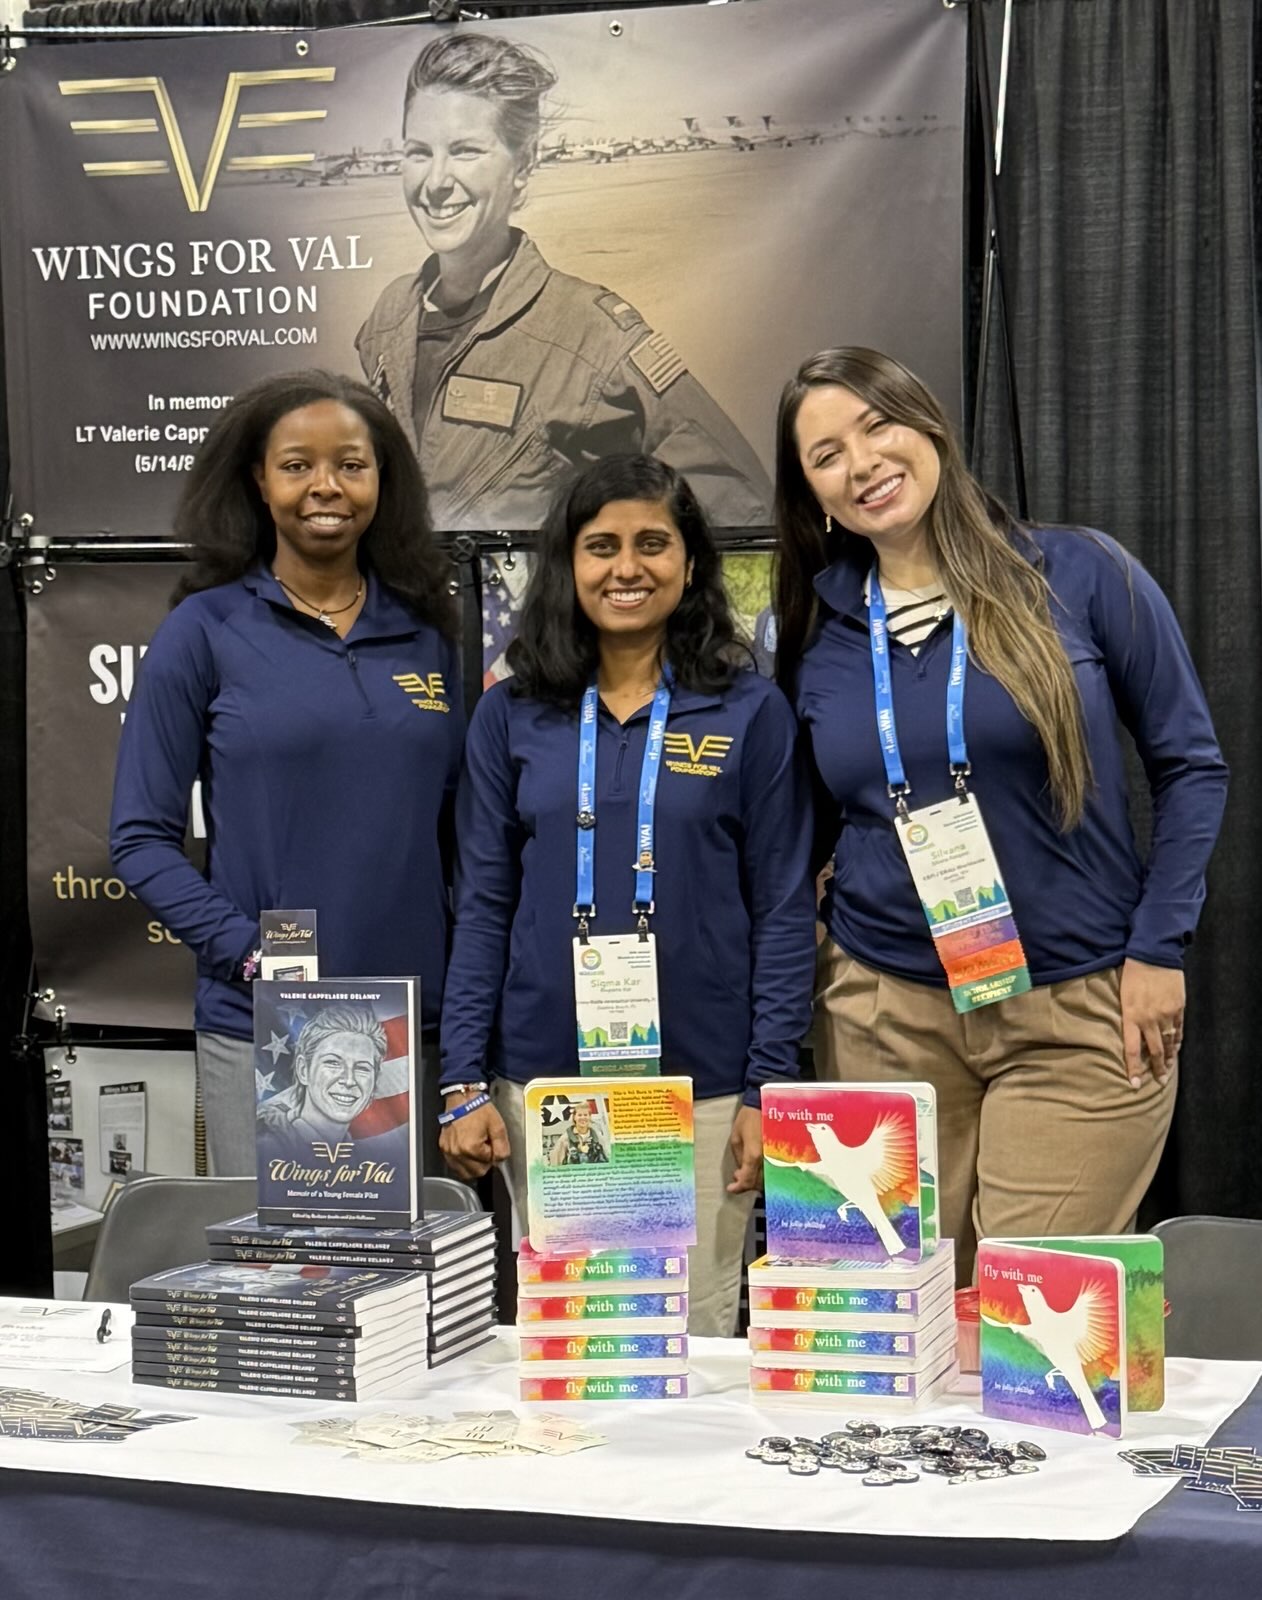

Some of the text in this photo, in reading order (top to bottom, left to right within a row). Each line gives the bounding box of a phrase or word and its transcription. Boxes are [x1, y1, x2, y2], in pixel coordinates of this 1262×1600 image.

[32, 235, 373, 281] WINGS FOR VAL
[89, 285, 318, 320] FOUNDATION
[90, 327, 318, 351] WWW.WINGSFORVAL.COM
[148, 394, 234, 411] In memor
[76, 426, 96, 443] LT
[100, 424, 160, 442] Valerie
[135, 454, 195, 473] (5/14/8
[52, 865, 137, 900] thro
[768, 1108, 834, 1122] fly with me
[268, 1159, 396, 1188] Wings for Val
[564, 1261, 637, 1277] fly with me
[984, 1264, 1043, 1284] fly with me
[795, 1291, 868, 1306] fly with me
[565, 1300, 637, 1316] fly with me
[566, 1341, 639, 1356] fly with me
[794, 1333, 866, 1348] fly with me
[794, 1373, 866, 1388] fly with me
[565, 1381, 638, 1398] fly with me
